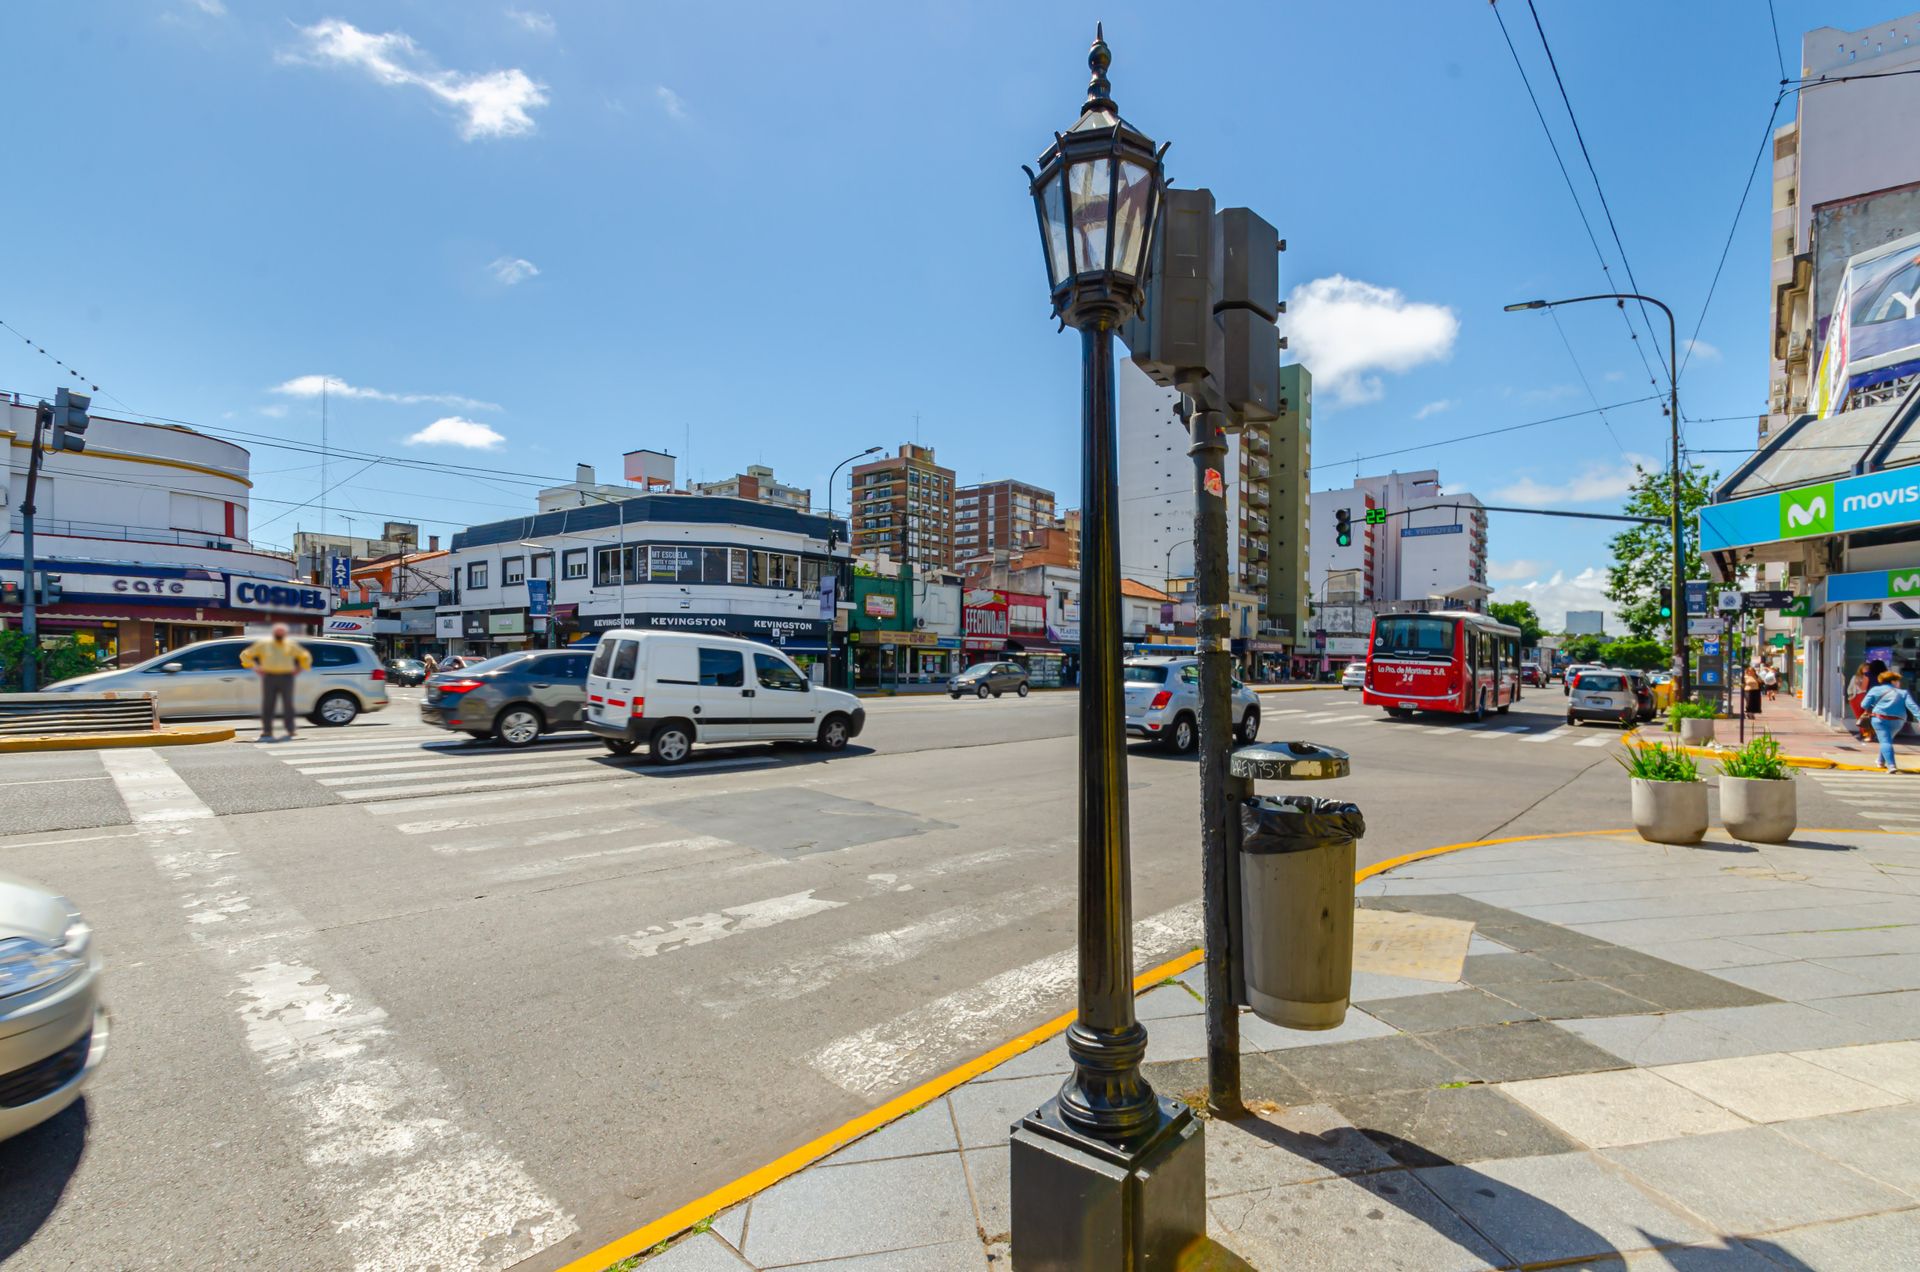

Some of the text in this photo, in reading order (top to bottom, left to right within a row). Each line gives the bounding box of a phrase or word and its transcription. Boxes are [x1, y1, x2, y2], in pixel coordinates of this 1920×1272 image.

[1843, 485, 1920, 512] movis
[1366, 508, 1386, 524] 22
[335, 557, 347, 585] TAXI
[594, 618, 635, 627] KEVINGSON
[651, 617, 726, 626] KEVINGSTON
[754, 620, 812, 630] KEVINGSTON
[966, 608, 996, 634] EFECTIVO
[1396, 666, 1404, 674] de
